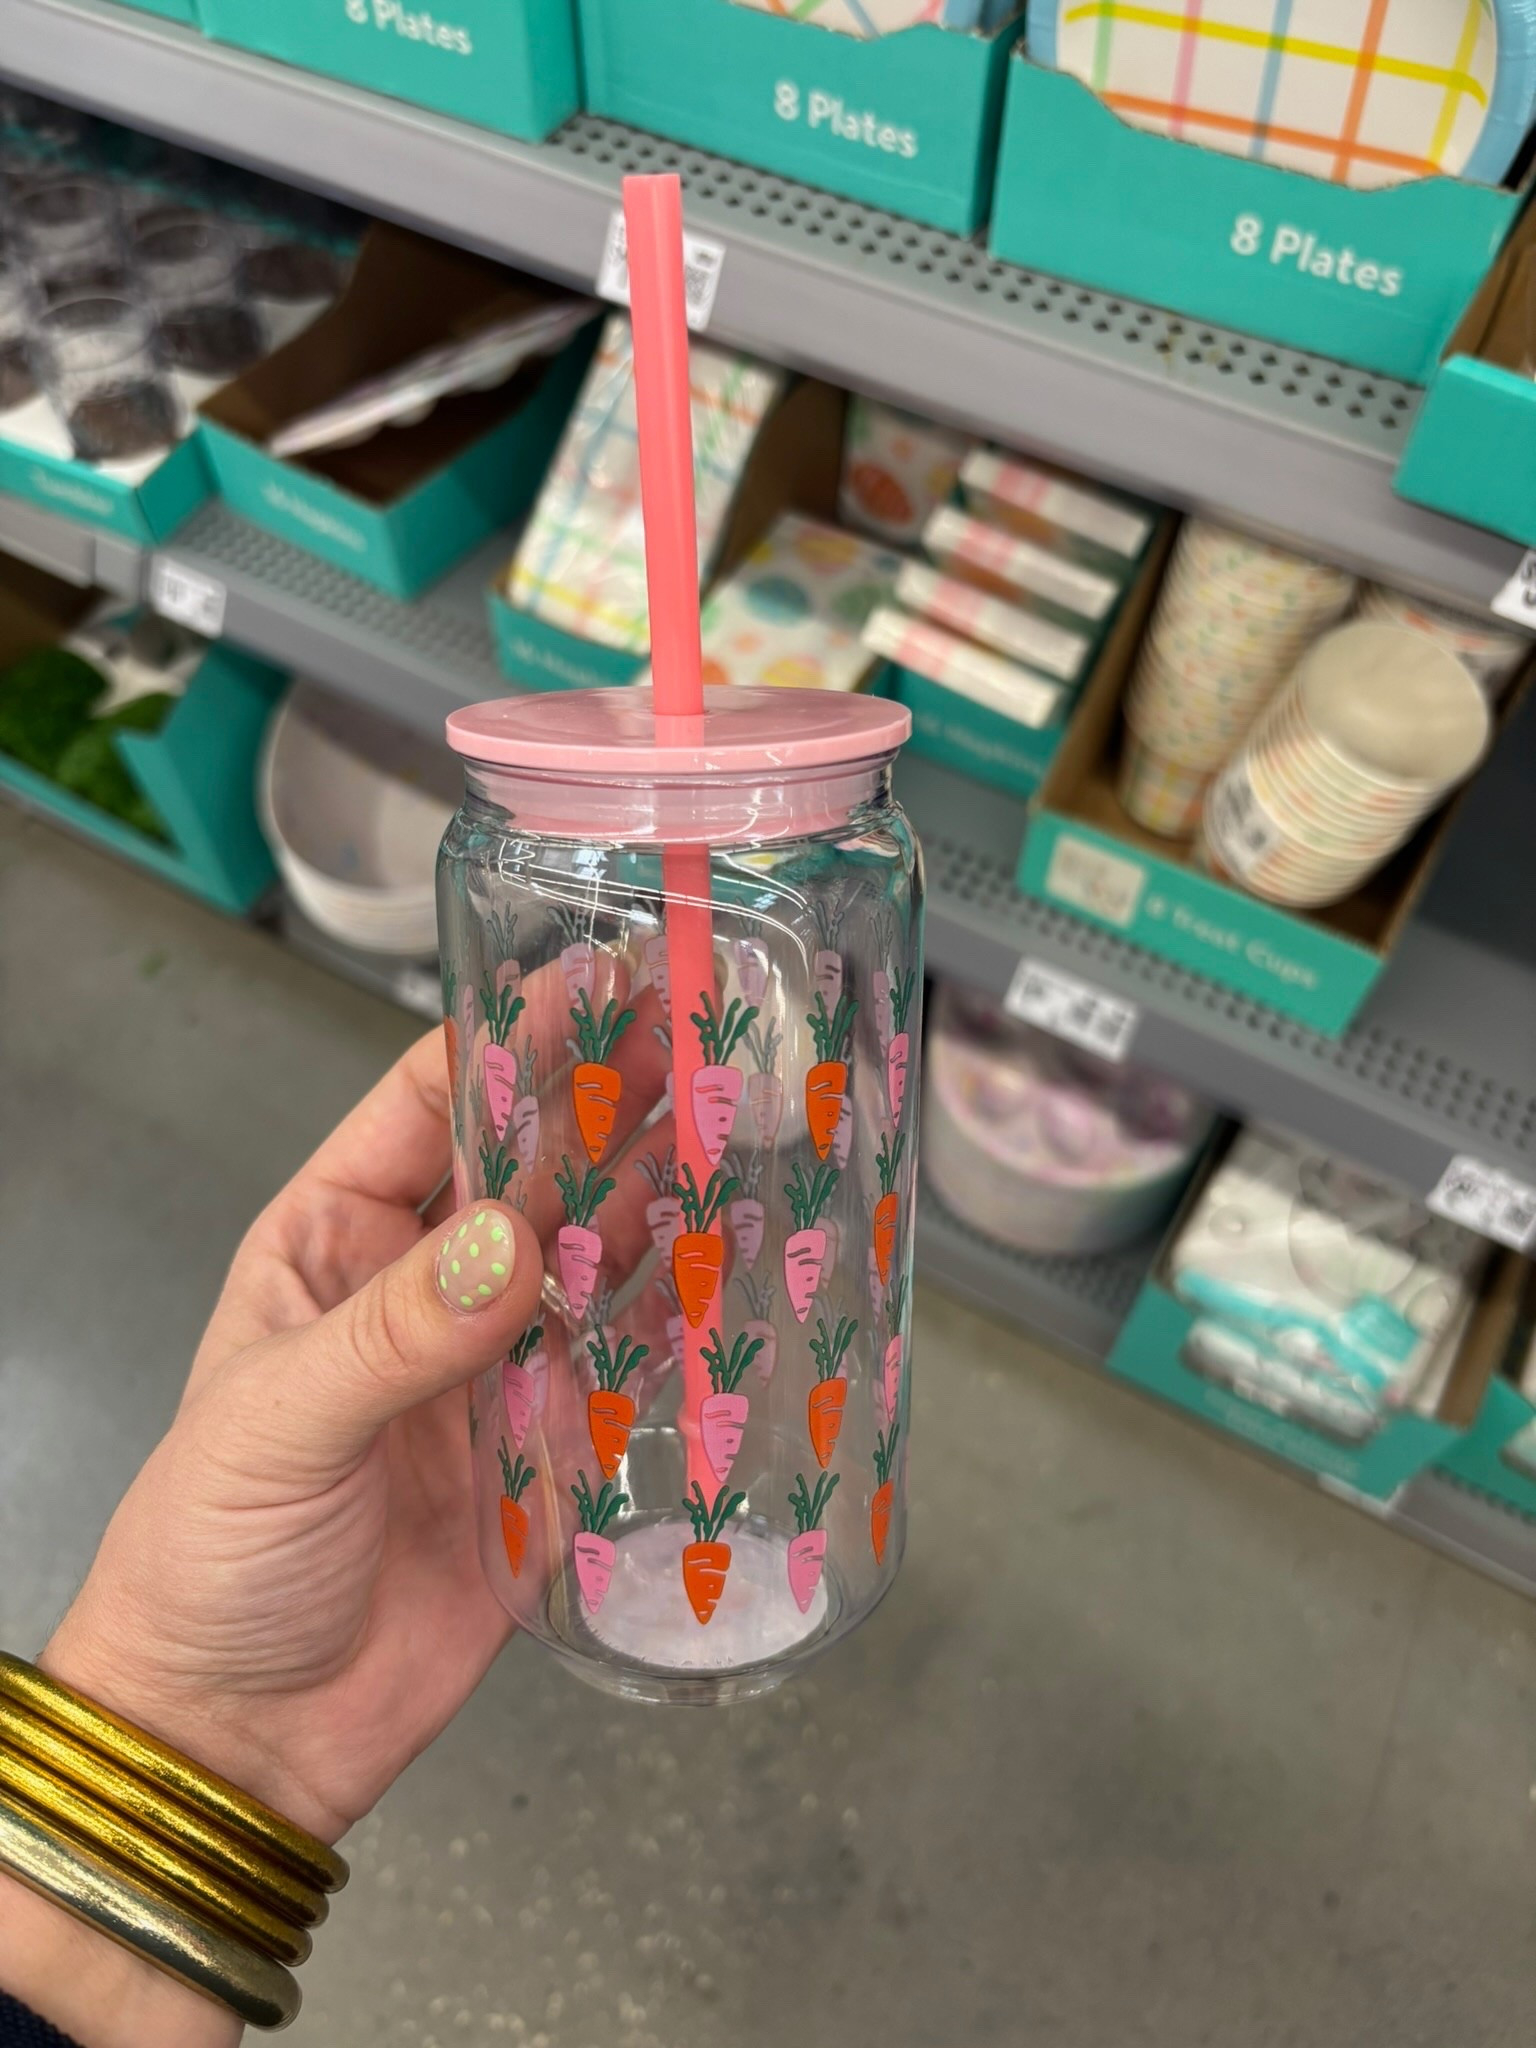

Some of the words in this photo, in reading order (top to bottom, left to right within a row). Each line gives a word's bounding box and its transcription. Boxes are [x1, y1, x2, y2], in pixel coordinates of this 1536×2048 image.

[371, 0, 473, 55] Plates
[775, 80, 799, 121] 8
[807, 89, 918, 158] Plates
[1230, 213, 1262, 256] 8
[1269, 224, 1402, 297] Plates
